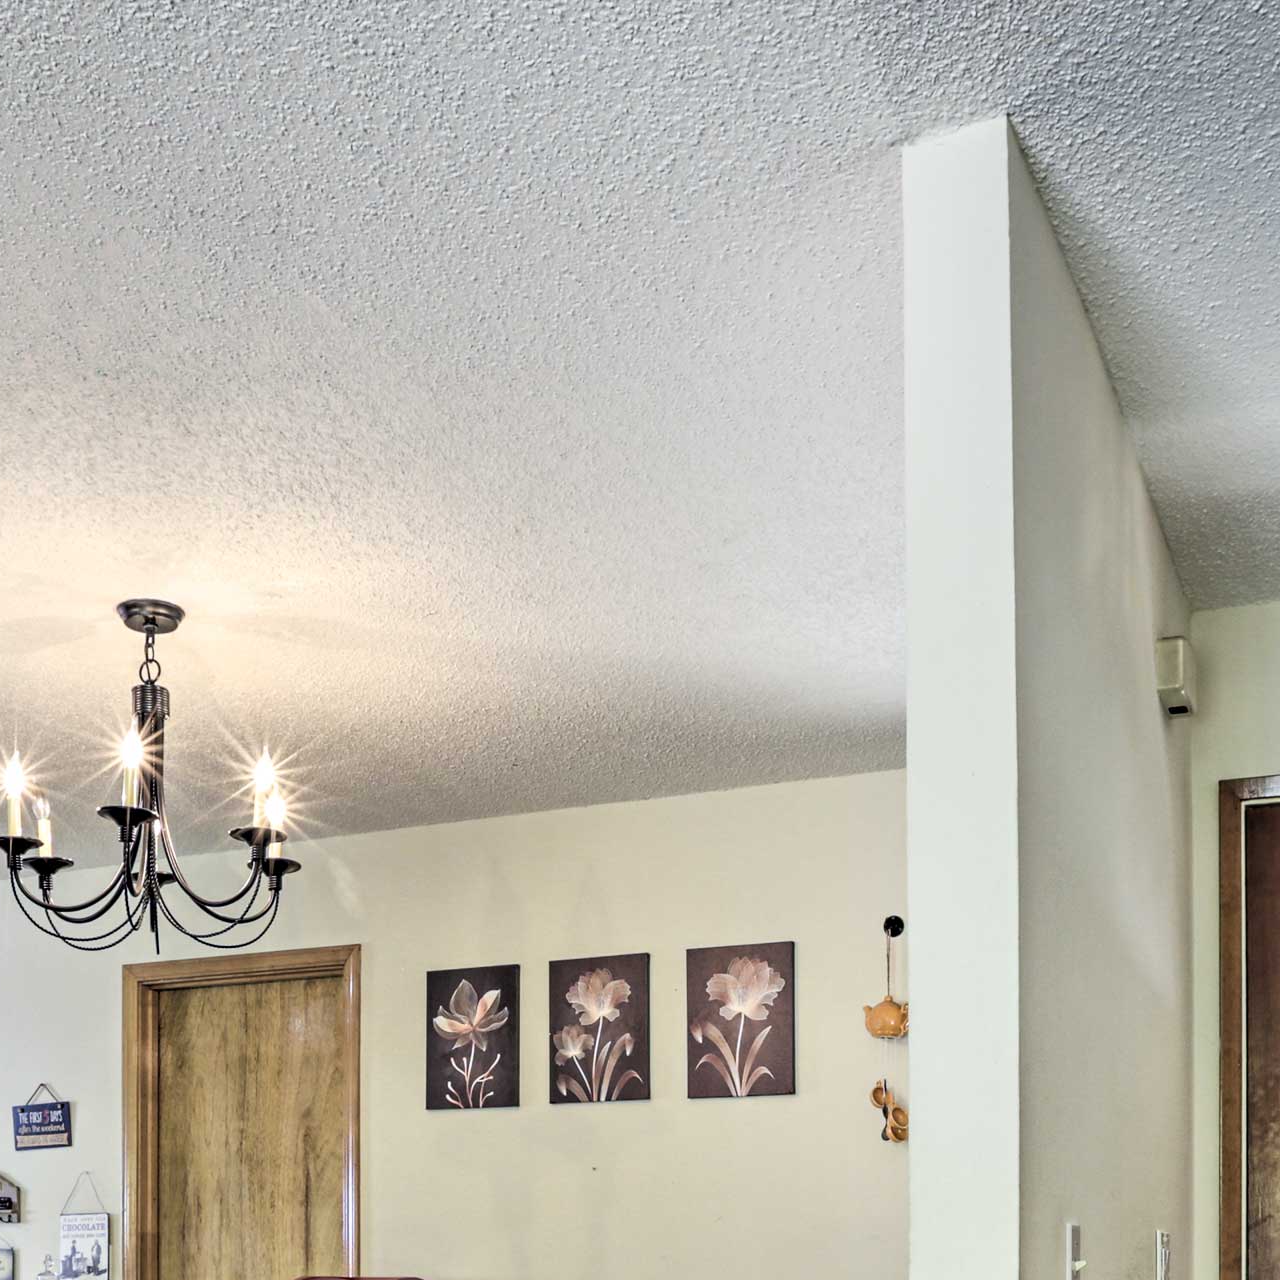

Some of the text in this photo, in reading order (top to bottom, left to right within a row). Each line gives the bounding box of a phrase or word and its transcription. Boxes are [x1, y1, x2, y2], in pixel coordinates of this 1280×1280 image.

[18, 1109, 63, 1124] THE FIRST 5 DAYS
[62, 1223, 105, 1232] CHOCOLATE
